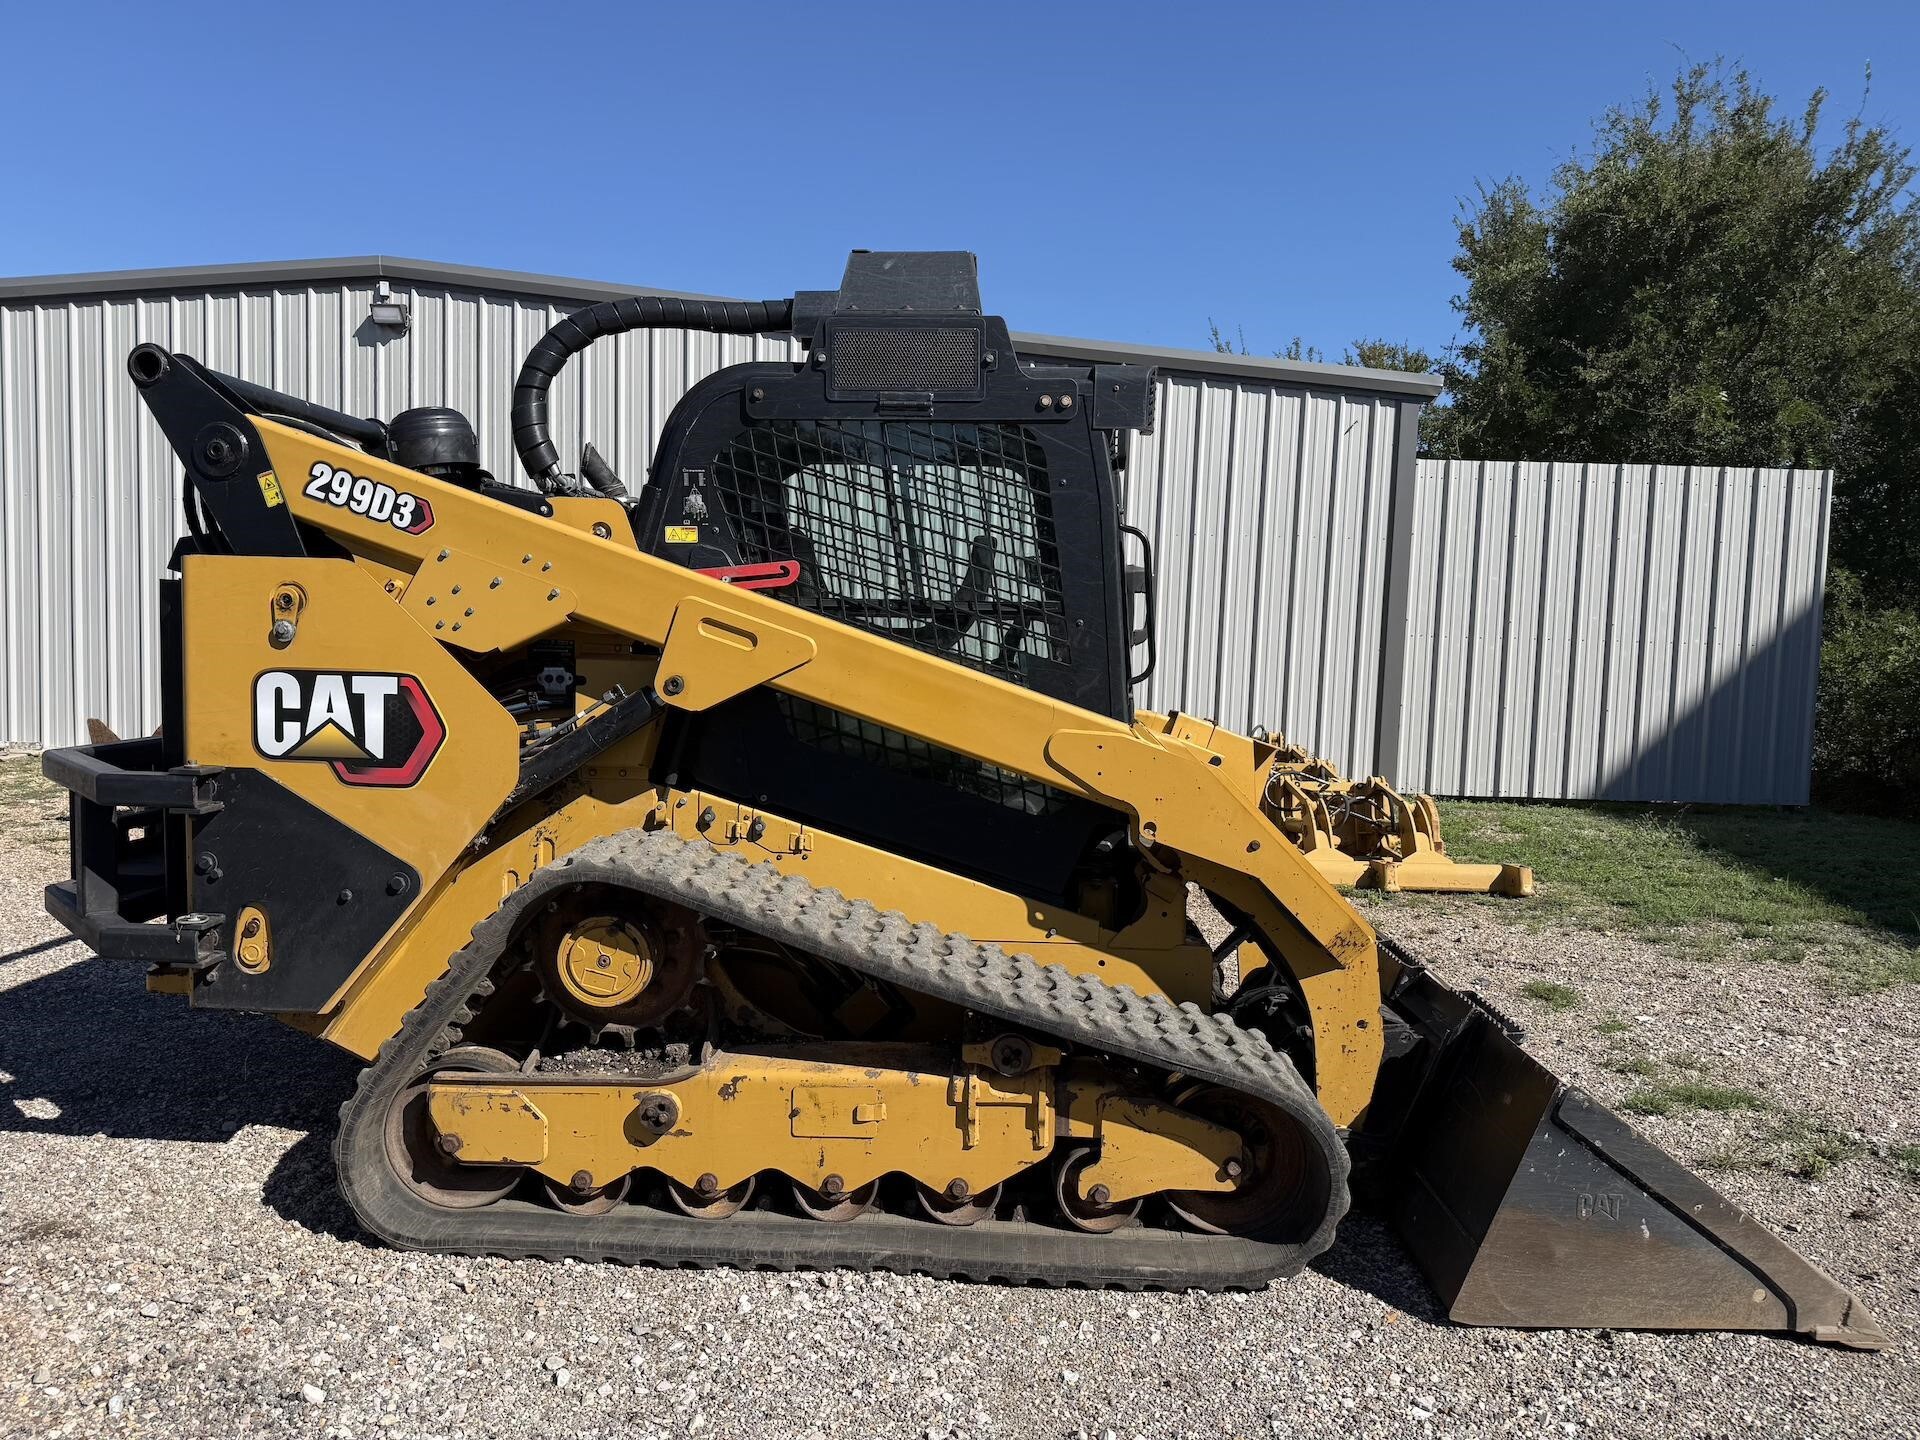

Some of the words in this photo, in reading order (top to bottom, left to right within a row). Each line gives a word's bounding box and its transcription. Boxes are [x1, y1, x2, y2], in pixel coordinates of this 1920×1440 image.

[304, 461, 417, 529] 299D3
[256, 671, 398, 760] CAT
[1576, 1193, 1623, 1221] CAT
